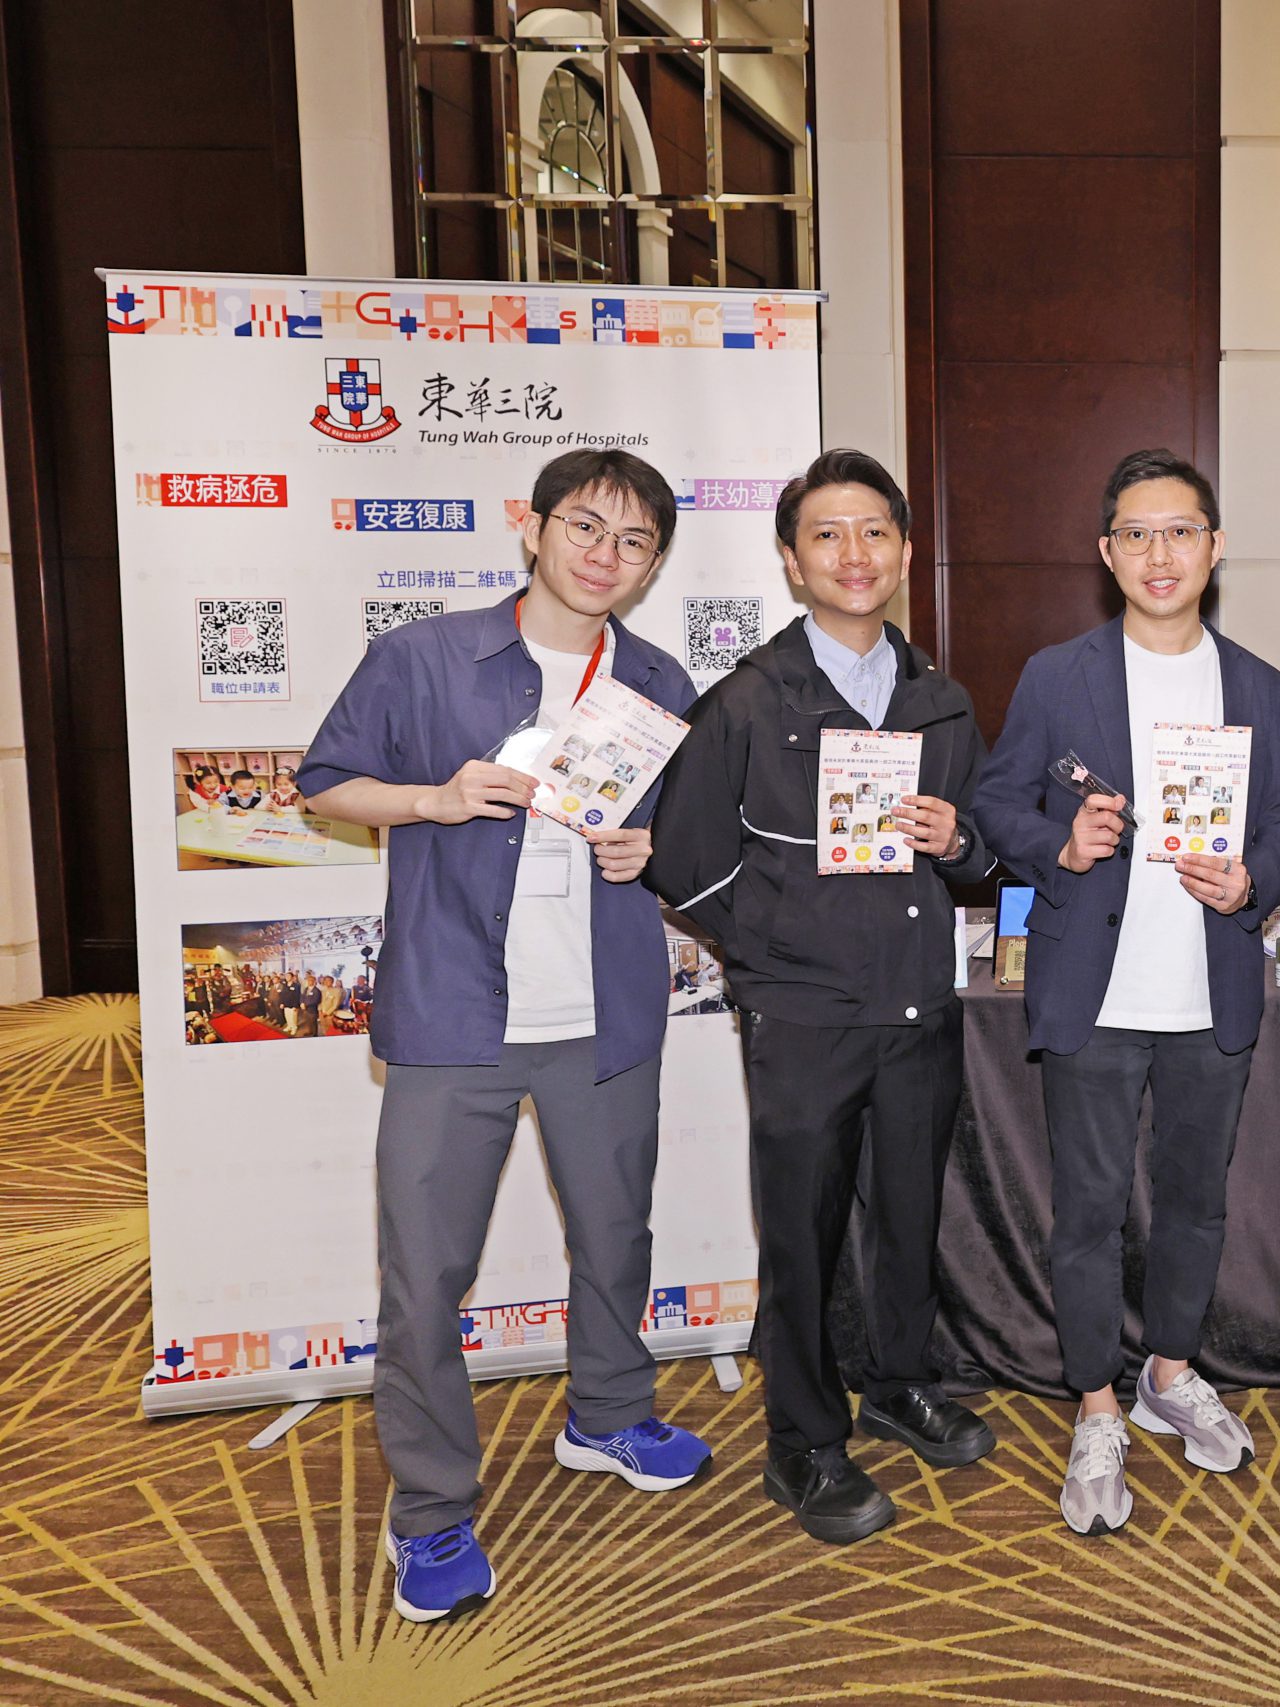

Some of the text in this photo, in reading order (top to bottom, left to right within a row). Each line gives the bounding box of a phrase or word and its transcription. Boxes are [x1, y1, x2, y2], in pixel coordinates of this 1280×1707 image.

[418, 373, 562, 423] 東華三院
[418, 430, 649, 449] Tung Wah Group of Hospitals
[167, 475, 279, 503] 救病拯危
[363, 501, 467, 530] 安老復康
[211, 681, 281, 695] 職位申請表
